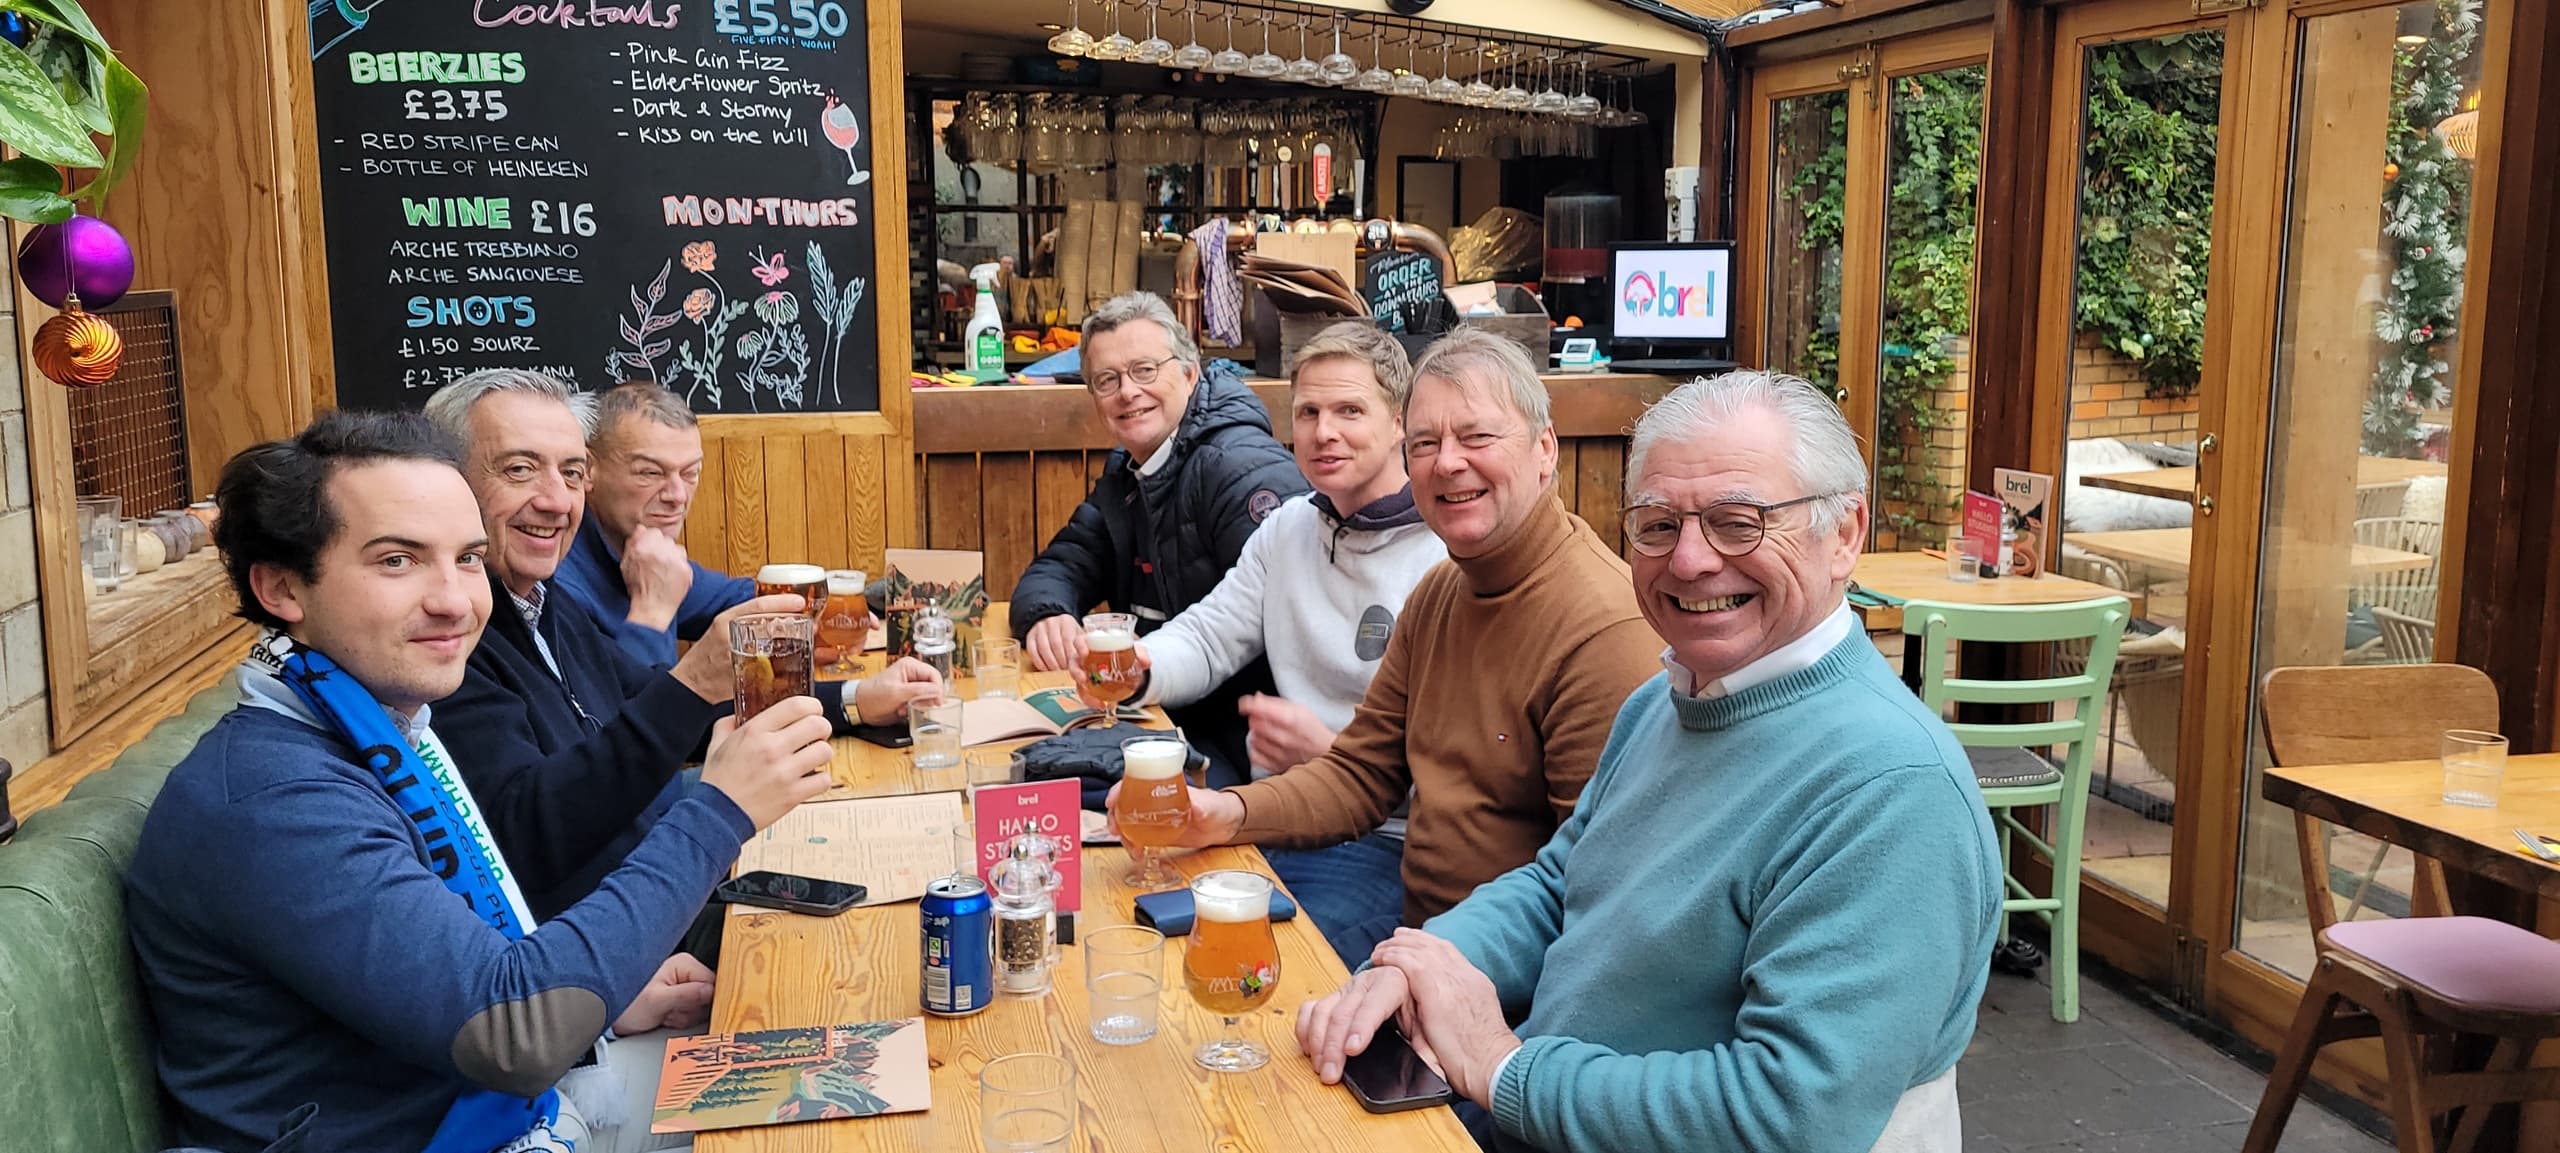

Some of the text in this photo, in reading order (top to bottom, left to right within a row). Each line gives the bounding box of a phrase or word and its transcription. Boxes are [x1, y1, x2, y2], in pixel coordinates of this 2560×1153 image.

[714, 0, 849, 38] £5.50
[731, 35, 756, 45] FIVE
[800, 40, 837, 54] WOAH!
[349, 52, 527, 84] BEERZIES
[627, 43, 789, 72] Pink Gin Fizz
[768, 76, 825, 99] Spritz
[404, 89, 508, 121] £3.75
[632, 98, 687, 119] Dark
[720, 102, 793, 128] Stormy
[360, 133, 560, 153] RED STRIPE CAN
[639, 126, 681, 144] Kiss
[690, 129, 715, 143] on
[723, 127, 762, 145] the
[363, 159, 589, 178] BOTTLE OF HEINEKEN
[401, 196, 597, 237] WINE £16
[662, 194, 858, 227] MON-THURS
[389, 239, 579, 259] ARCHE TREBBIANO
[388, 266, 584, 284] ARCHE SANGIOVESE
[1378, 257, 1432, 291] ORDER
[1658, 270, 1715, 318] brel
[406, 295, 536, 328] SHOTS
[398, 336, 541, 358] £1.50 SOURZ
[2005, 475, 2032, 494] brel
[1018, 793, 1038, 806] brel
[984, 835, 1073, 860] STTS
